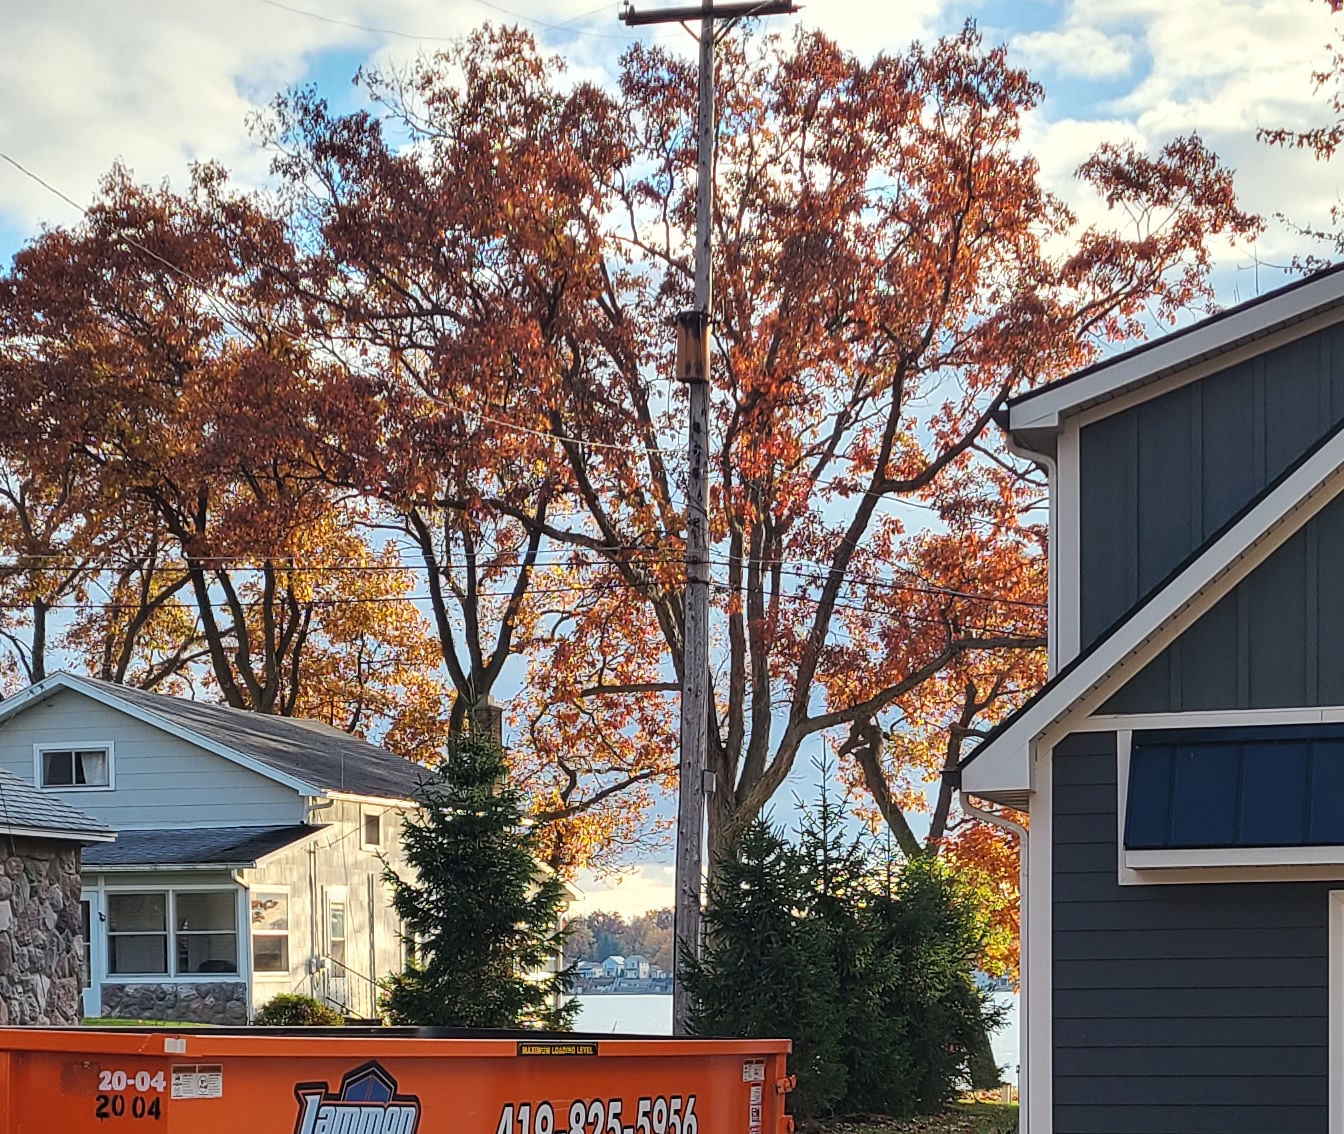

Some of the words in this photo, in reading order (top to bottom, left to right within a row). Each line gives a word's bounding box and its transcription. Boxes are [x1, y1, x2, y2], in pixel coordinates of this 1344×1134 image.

[98, 1070, 167, 1093] 20-04
[95, 1094, 125, 1119] 20
[132, 1096, 161, 1120] 04
